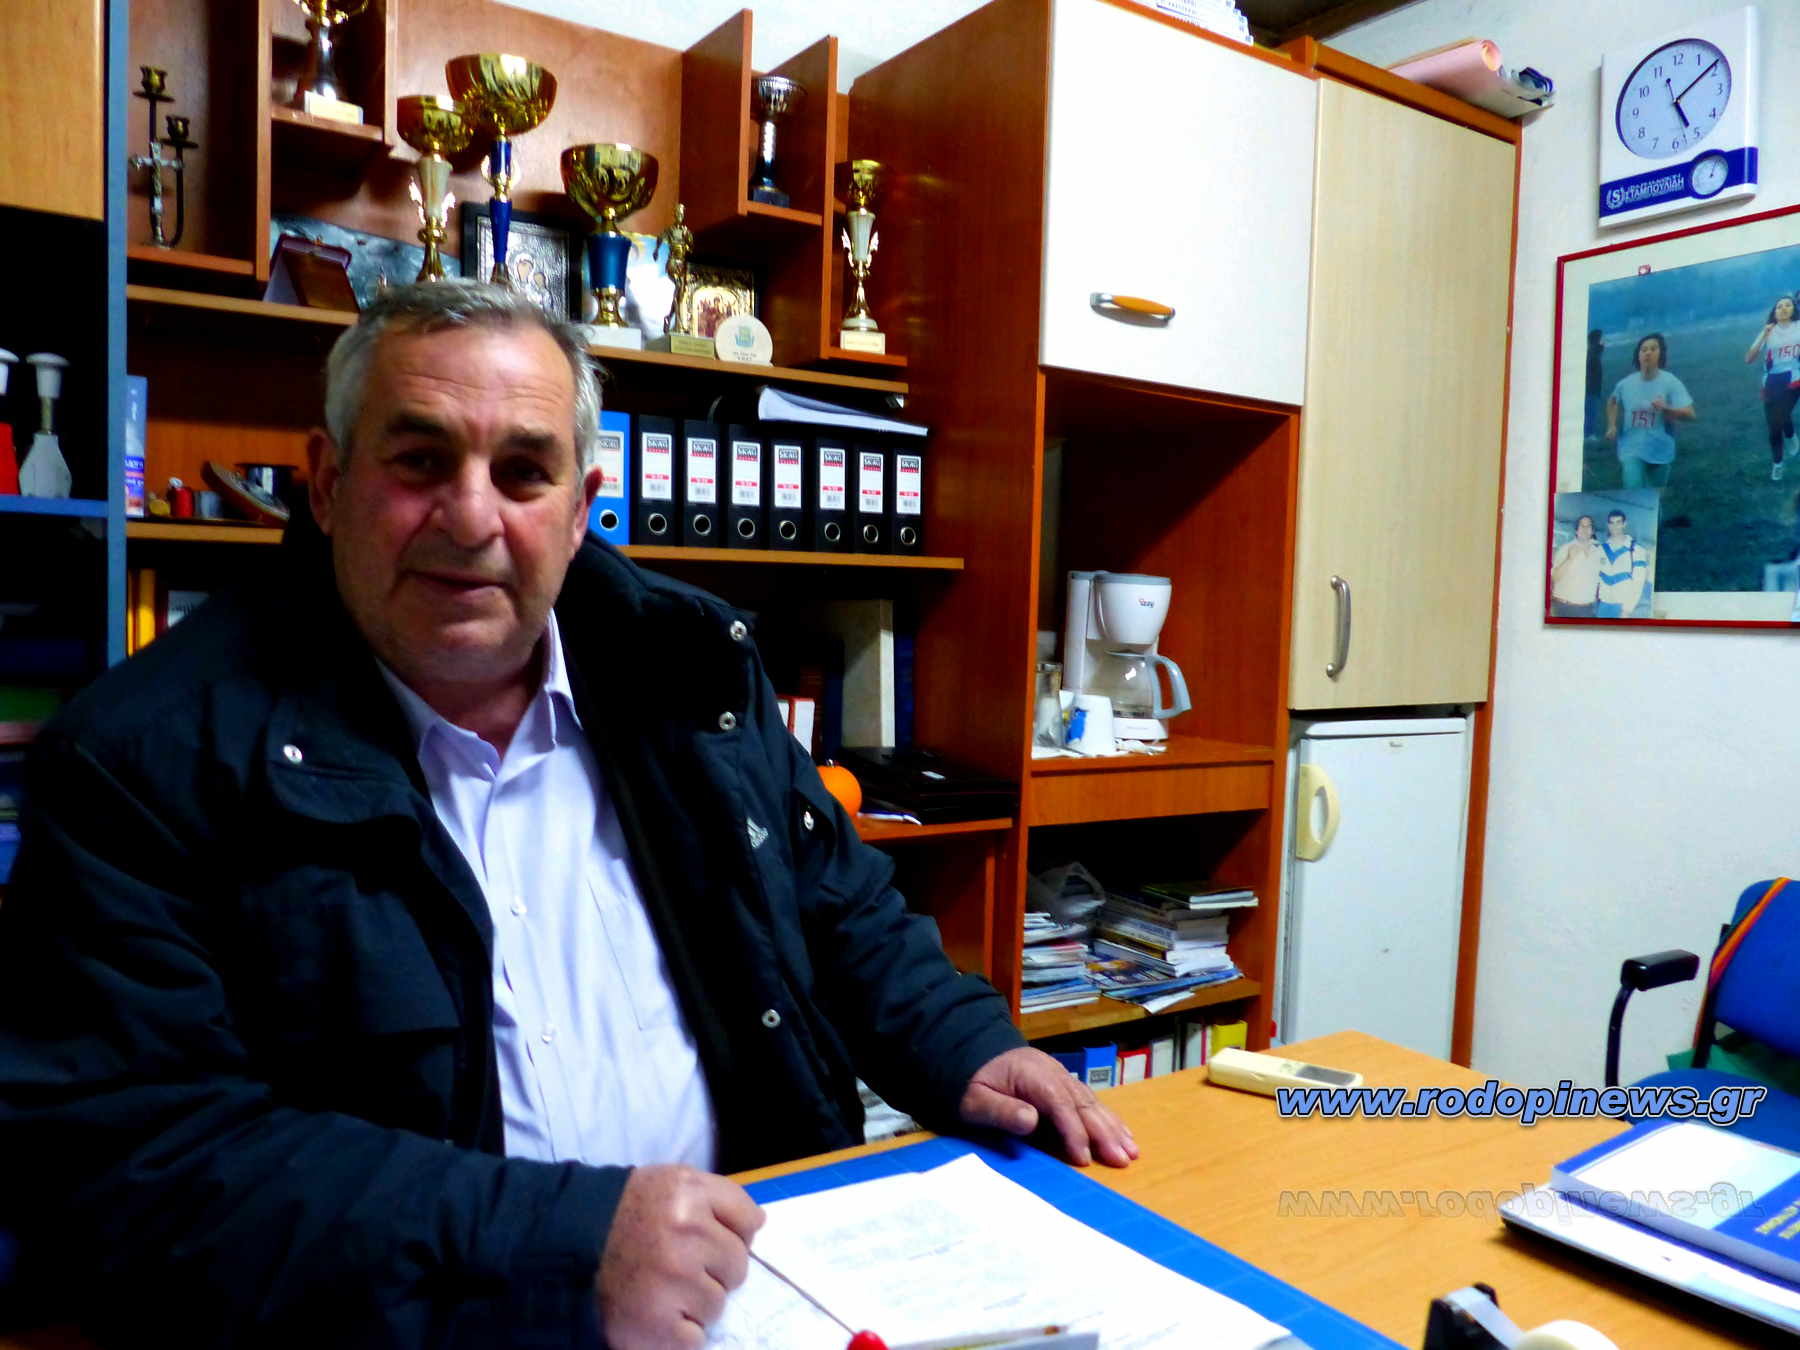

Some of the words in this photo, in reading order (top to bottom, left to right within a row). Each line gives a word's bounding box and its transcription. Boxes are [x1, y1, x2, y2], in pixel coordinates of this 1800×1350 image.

[1673, 53, 1684, 66] 12
[1653, 66, 1663, 79] 11
[1639, 85, 1650, 98] 10
[1715, 82, 1724, 96] 3
[1632, 107, 1640, 119] 9
[1708, 107, 1717, 119] 4
[1637, 126, 1646, 139] 8
[1693, 126, 1701, 138] 5
[1652, 137, 1659, 150] 7
[1671, 138, 1680, 150] 6
[1632, 409, 1656, 428] 151
